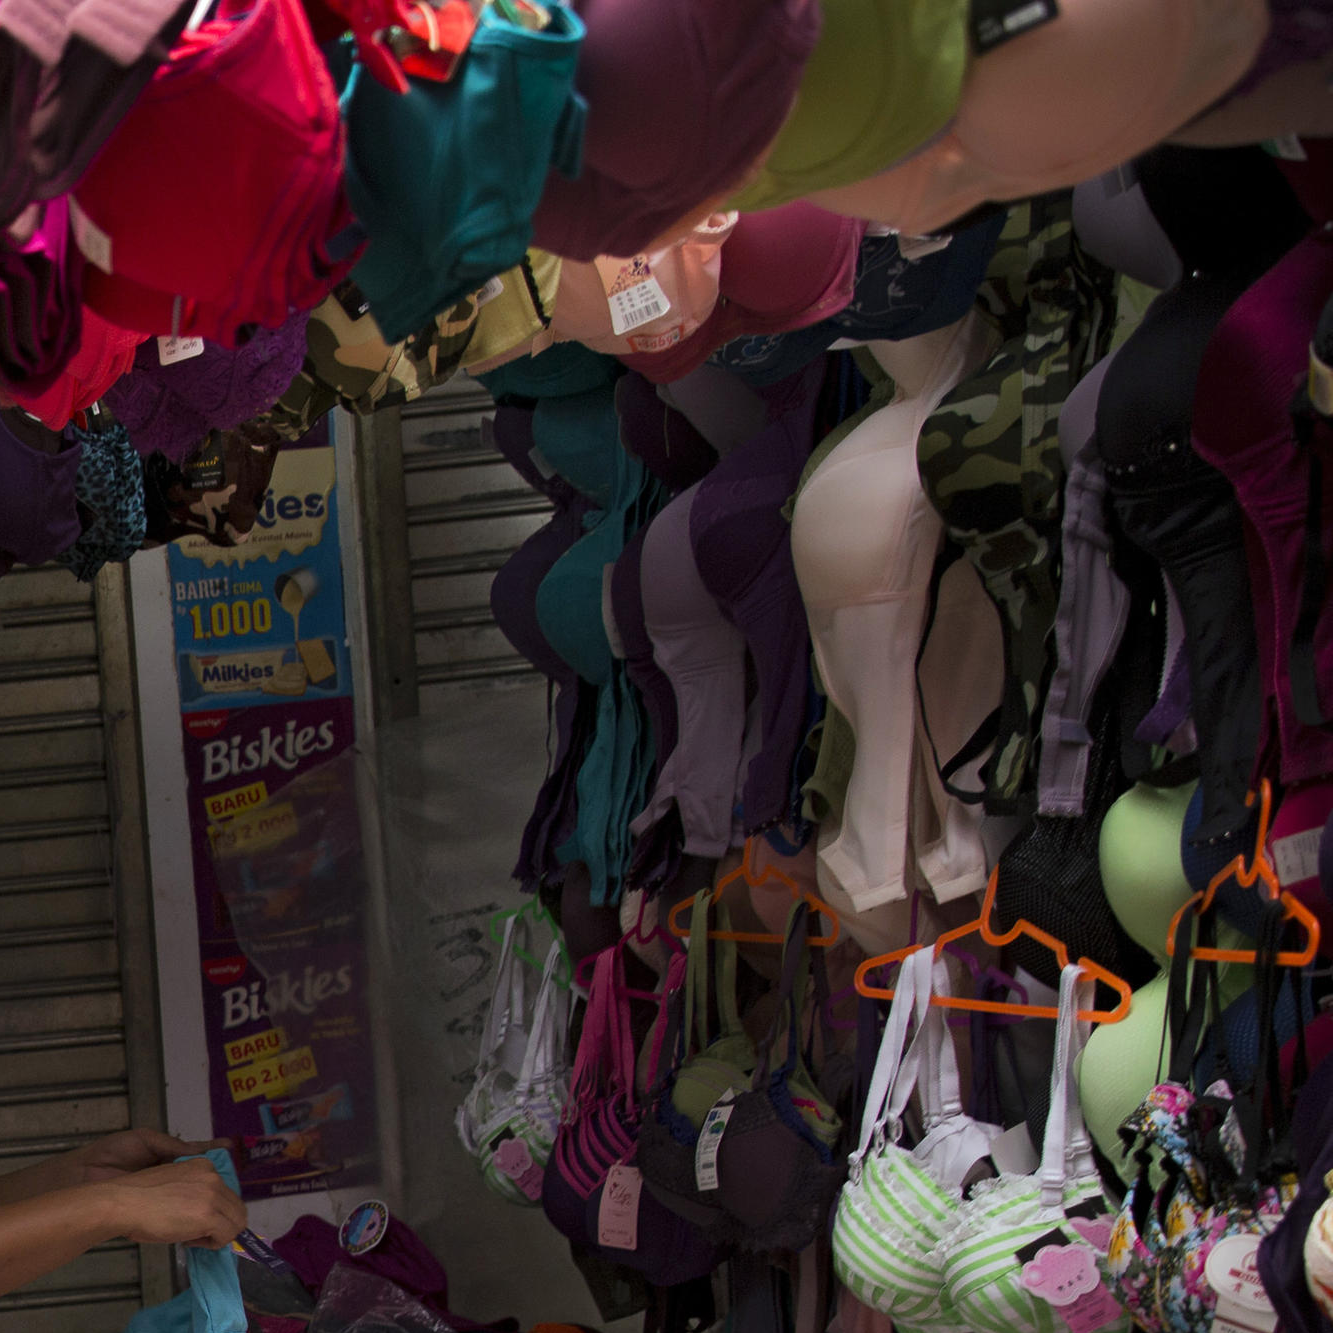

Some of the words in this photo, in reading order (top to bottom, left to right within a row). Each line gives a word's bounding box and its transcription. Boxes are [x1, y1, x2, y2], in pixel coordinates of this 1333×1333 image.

[233, 581, 263, 596] CUMA
[189, 598, 272, 641] 1.000
[202, 661, 274, 683] Milkies
[201, 719, 334, 784] Biskies
[211, 789, 261, 815] BARU
[221, 965, 353, 1030] Biskies
[231, 1031, 280, 1060] BARU
[232, 1076, 257, 1093] Rp
[261, 1054, 312, 1084] 2.000
